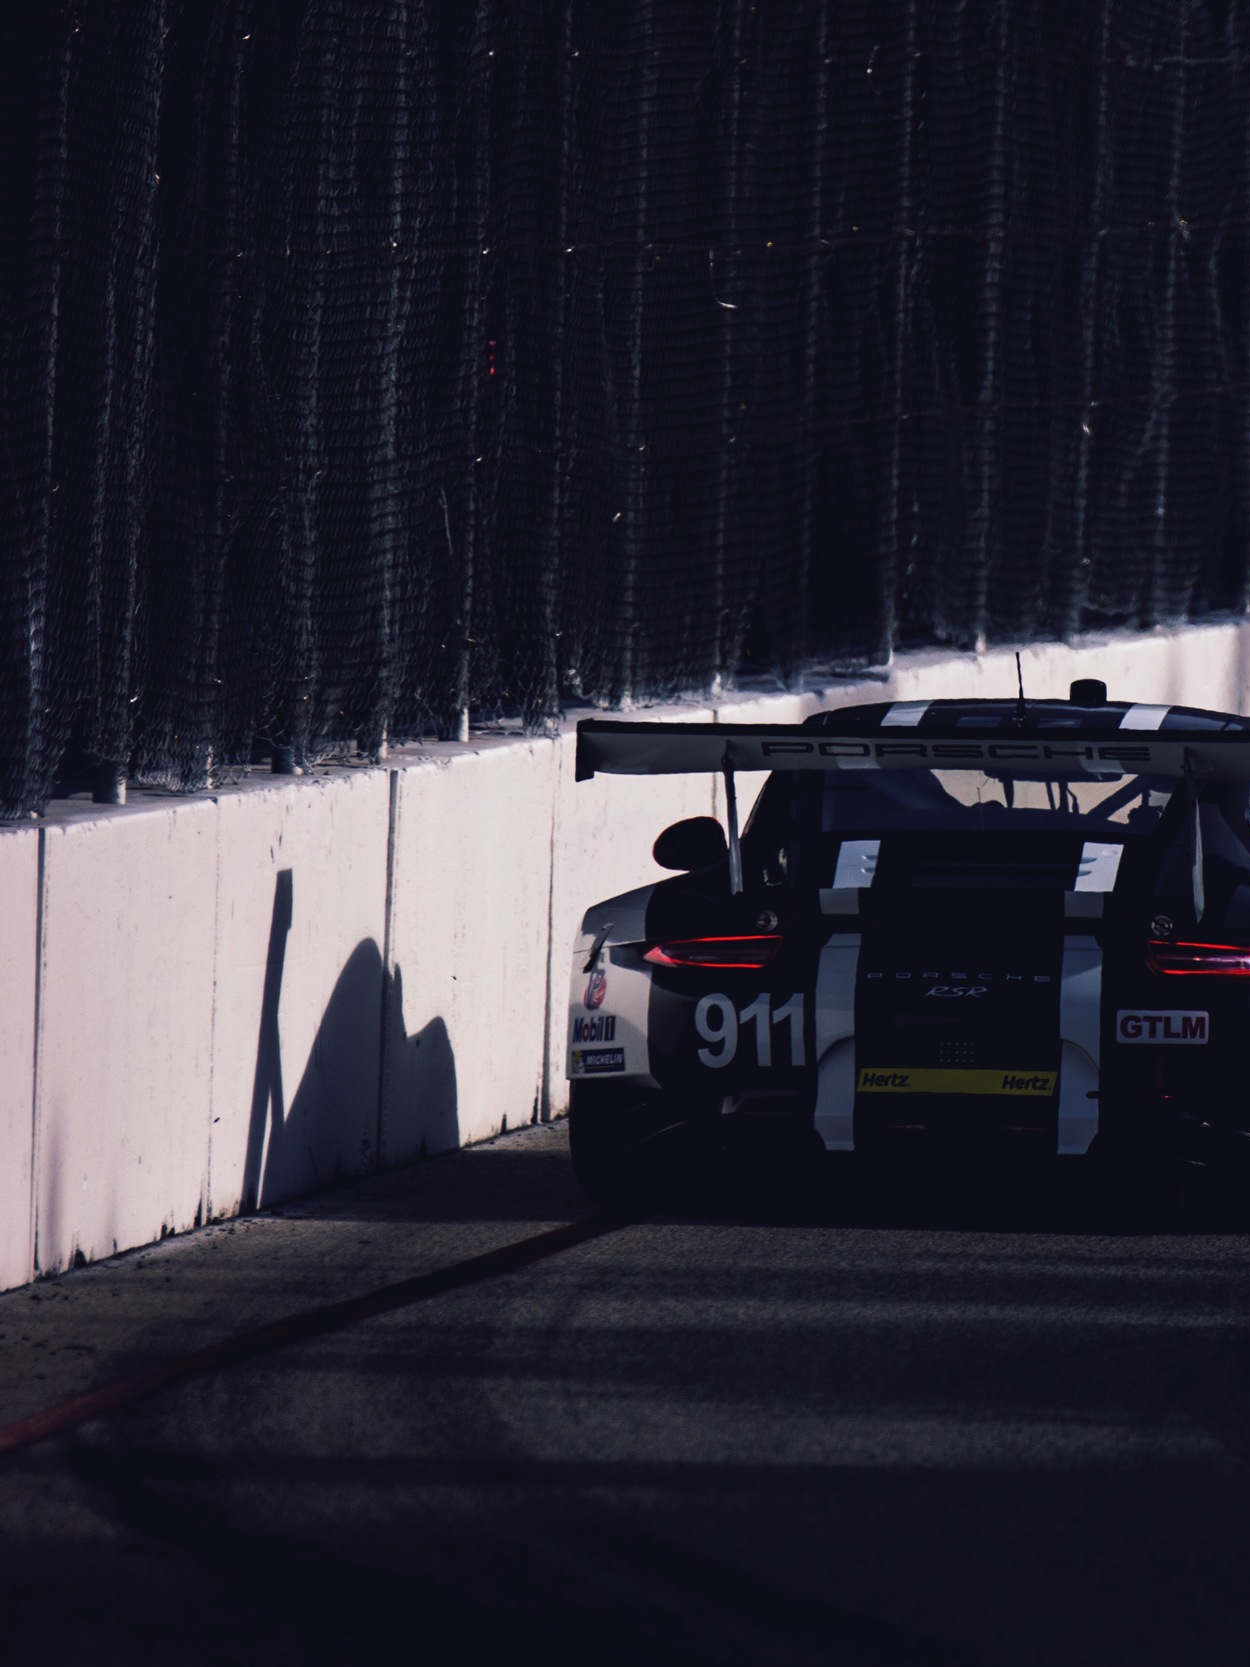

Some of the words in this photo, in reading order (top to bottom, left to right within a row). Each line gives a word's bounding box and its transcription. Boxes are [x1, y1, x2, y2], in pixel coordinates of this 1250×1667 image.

[761, 740, 1150, 761] PORSCHE
[867, 972, 1050, 982] PORSCHE
[924, 986, 988, 997] RSR
[695, 993, 806, 1068] 911
[1120, 1016, 1205, 1039] GTLM
[586, 1053, 623, 1065] MICHELIN
